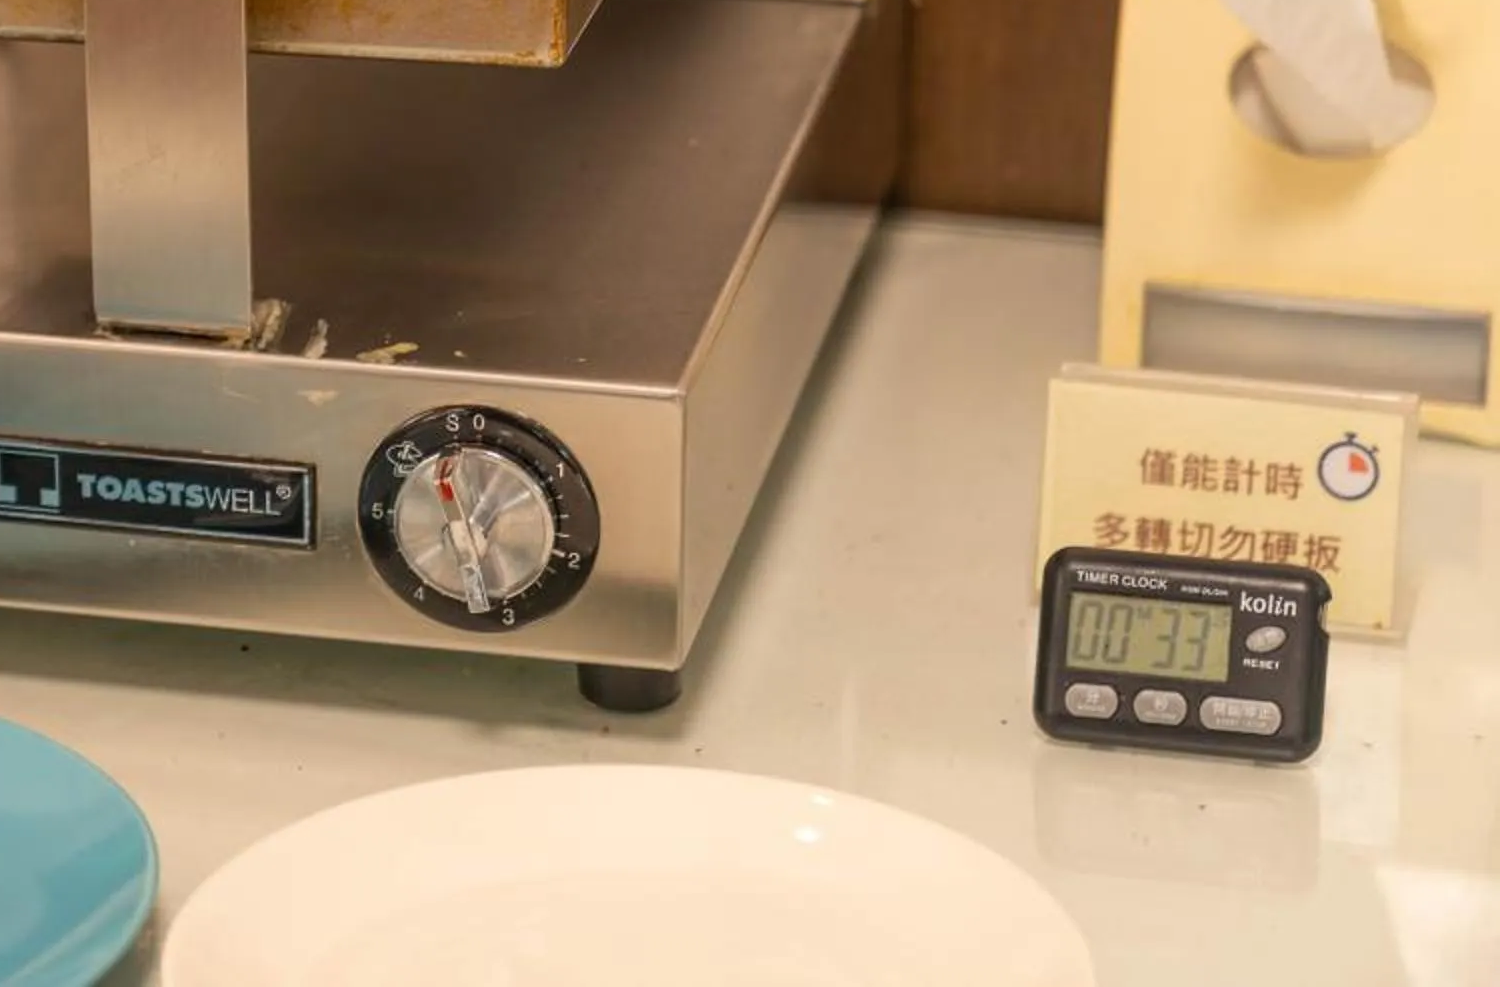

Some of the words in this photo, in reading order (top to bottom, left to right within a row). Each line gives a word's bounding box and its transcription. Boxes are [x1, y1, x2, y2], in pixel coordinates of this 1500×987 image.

[446, 414, 459, 432] S
[556, 463, 565, 478] 1
[1140, 447, 1304, 501] 僅能計時
[371, 503, 384, 520] 5
[568, 552, 581, 570] 2
[1076, 569, 1119, 586] TIMER
[1122, 575, 1168, 591] CLOCK
[1240, 591, 1297, 617] kolin
[502, 608, 515, 626] 3
